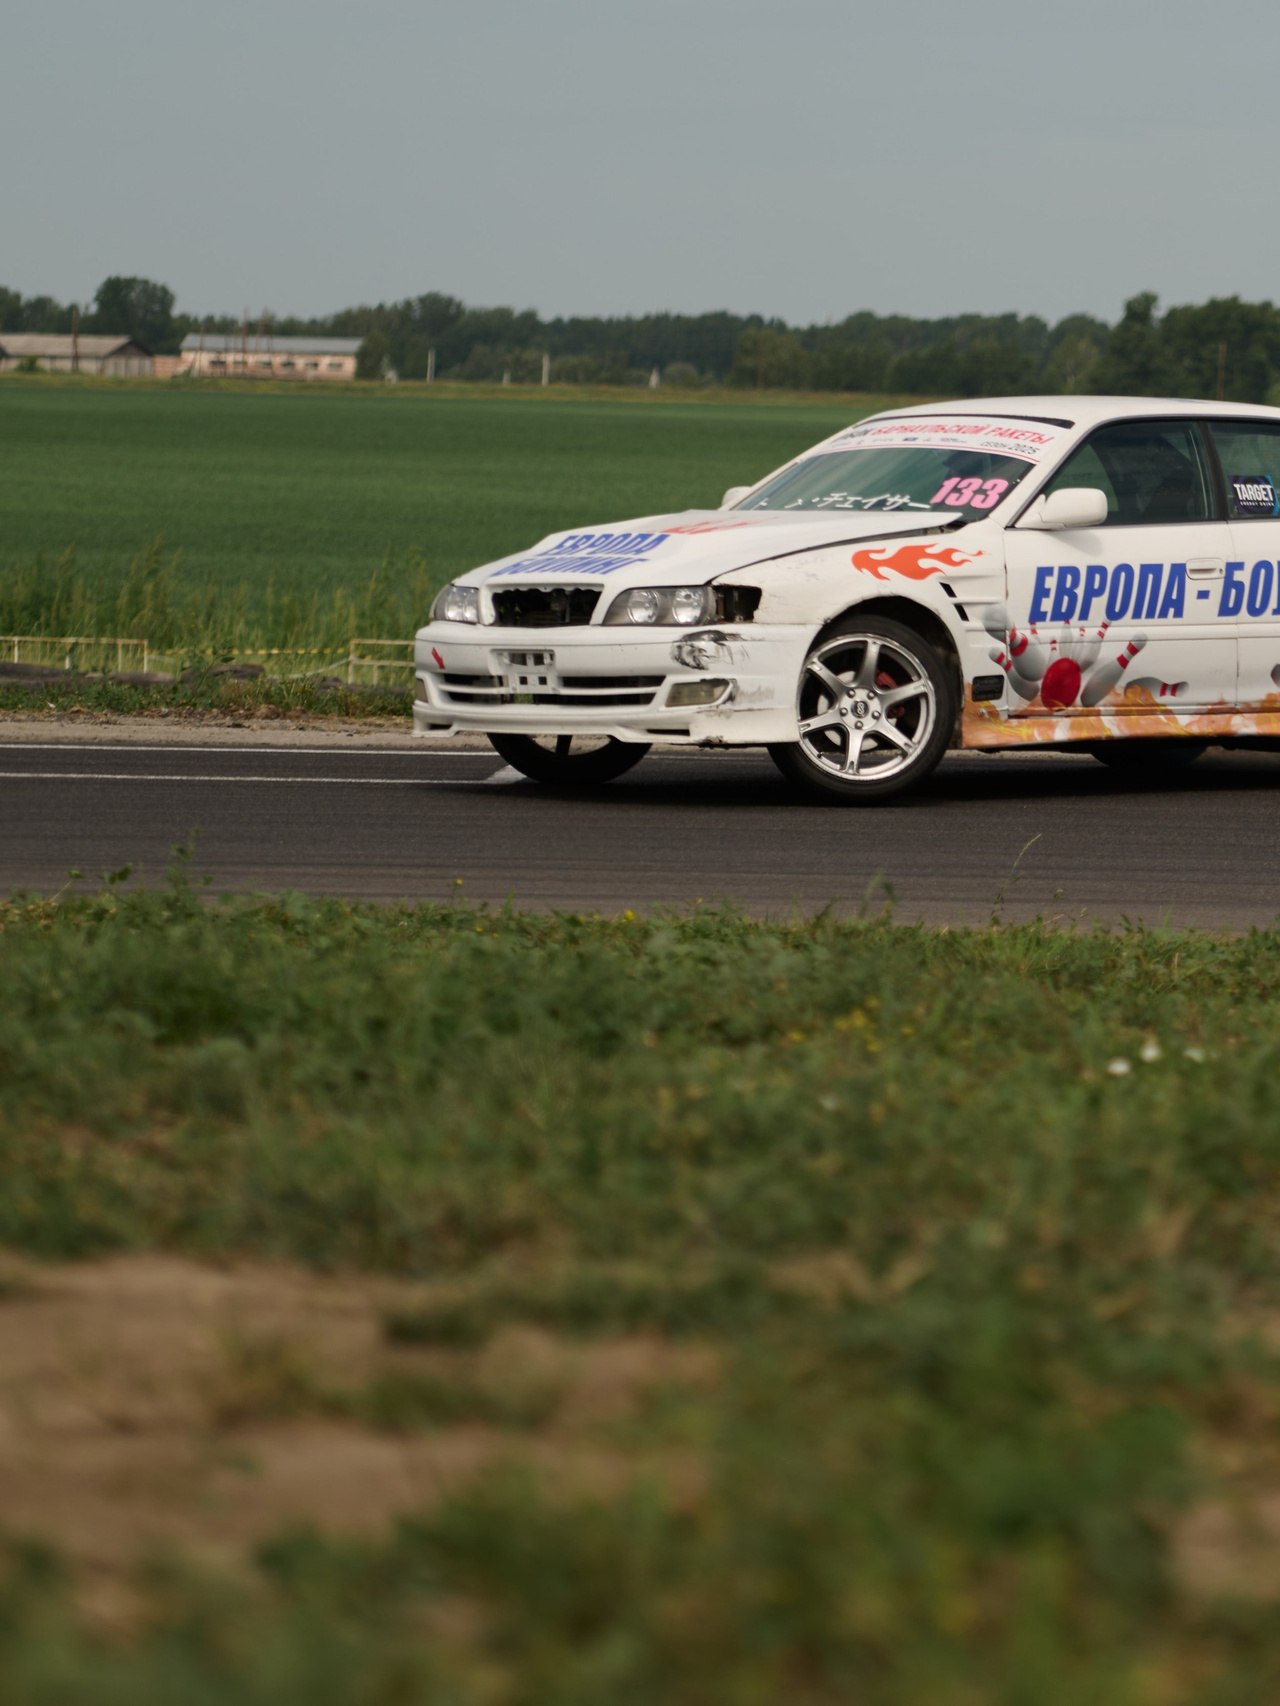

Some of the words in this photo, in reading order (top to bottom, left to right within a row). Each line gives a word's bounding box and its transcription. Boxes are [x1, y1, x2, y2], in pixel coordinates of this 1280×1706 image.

[985, 426, 1055, 445] РАКЕТЫ
[930, 477, 1009, 509] 133
[1233, 483, 1274, 502] TARGET
[534, 533, 671, 557] ЕВРОПА
[489, 556, 651, 577] БОУЛИНГ
[1028, 562, 1187, 623] ЕВРОПА
